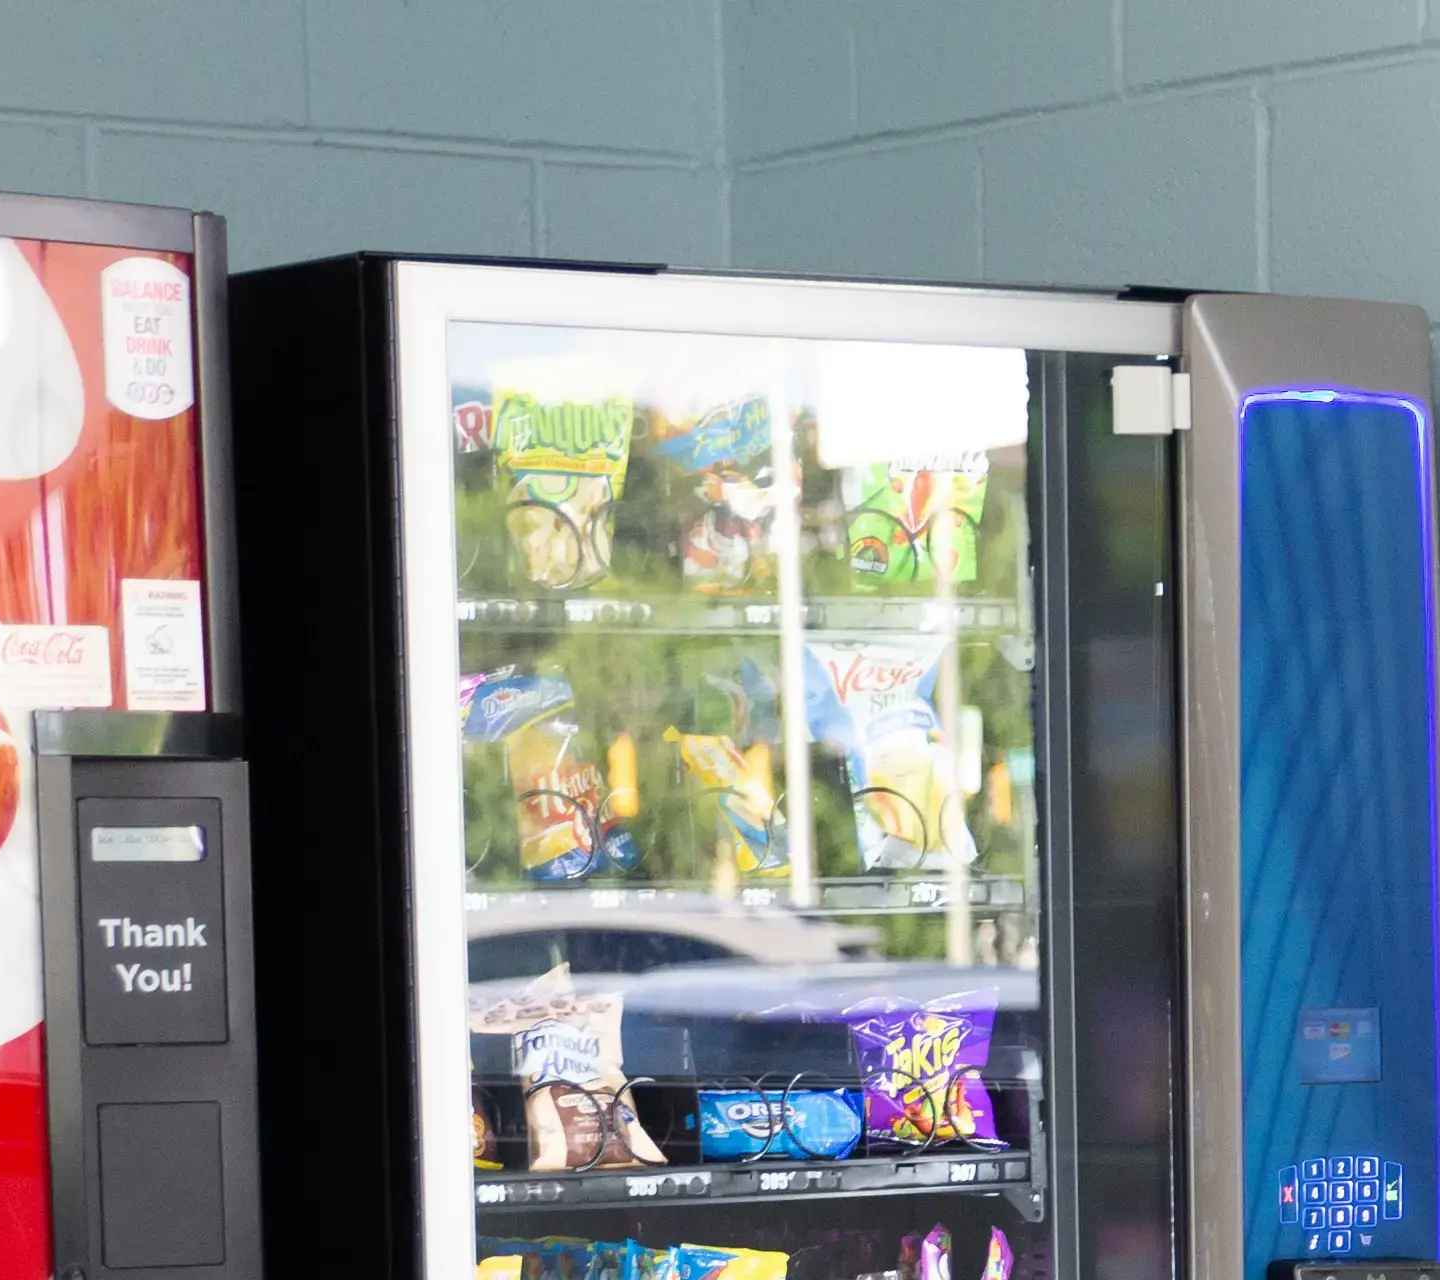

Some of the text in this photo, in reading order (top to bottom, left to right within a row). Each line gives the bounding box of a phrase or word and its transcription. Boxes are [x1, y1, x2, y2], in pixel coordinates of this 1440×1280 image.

[111, 279, 183, 302] BALANCE
[134, 316, 161, 334] EAT
[126, 337, 173, 357] DRINK
[146, 358, 166, 376] DO
[98, 918, 207, 948] Thank
[116, 963, 193, 993] You!
[950, 1165, 976, 1181] 307
[1311, 1164, 1318, 1176] 1
[1337, 1162, 1345, 1174] 2
[1363, 1161, 1371, 1173] 3
[1311, 1186, 1320, 1199] 4
[1336, 1186, 1345, 1199] 5
[1363, 1184, 1371, 1197] 6
[1311, 1212, 1318, 1224] 7
[1336, 1210, 1345, 1223] 8
[1362, 1209, 1370, 1222] 9
[1336, 1235, 1343, 1248] 0
